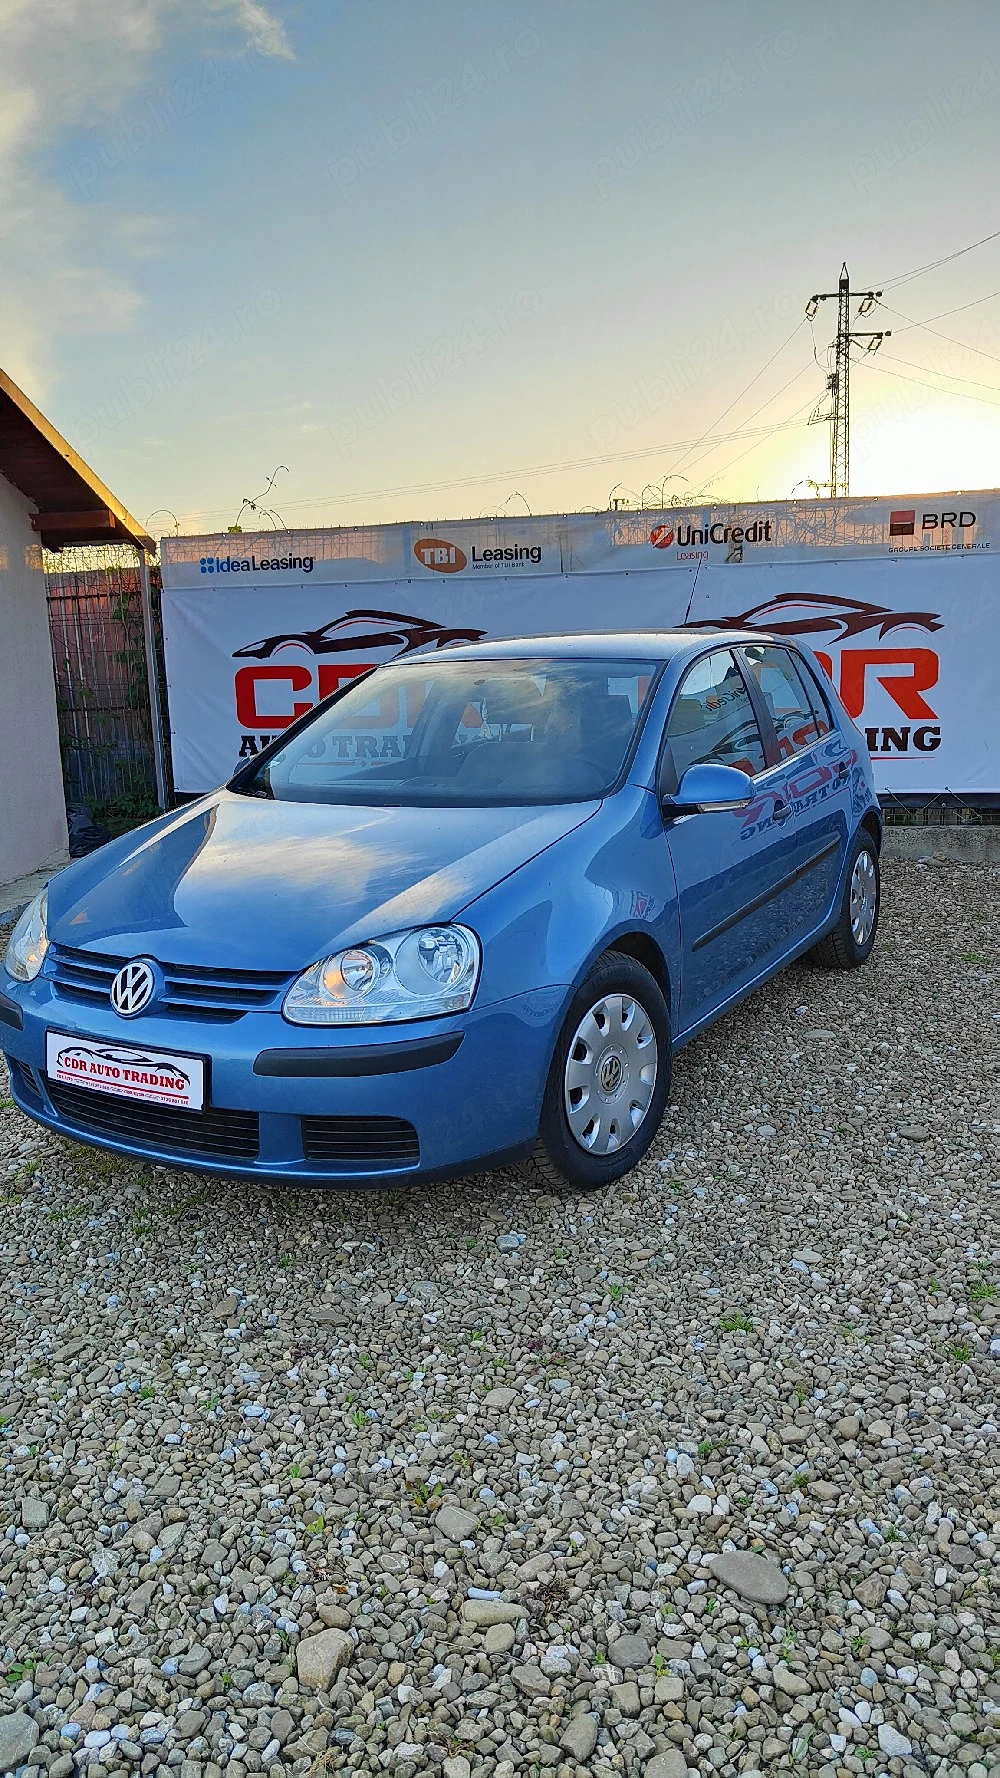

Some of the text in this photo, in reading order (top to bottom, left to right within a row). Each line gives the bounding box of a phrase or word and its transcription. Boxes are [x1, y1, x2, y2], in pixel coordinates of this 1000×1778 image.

[922, 512, 977, 529] BRD
[677, 520, 772, 547] UniCredit
[421, 544, 542, 564] TBI Leasing
[676, 551, 709, 561] Leasing
[64, 1056, 88, 1072] CDR
[89, 1063, 121, 1079] AUTO
[123, 1070, 185, 1091] TRADING
